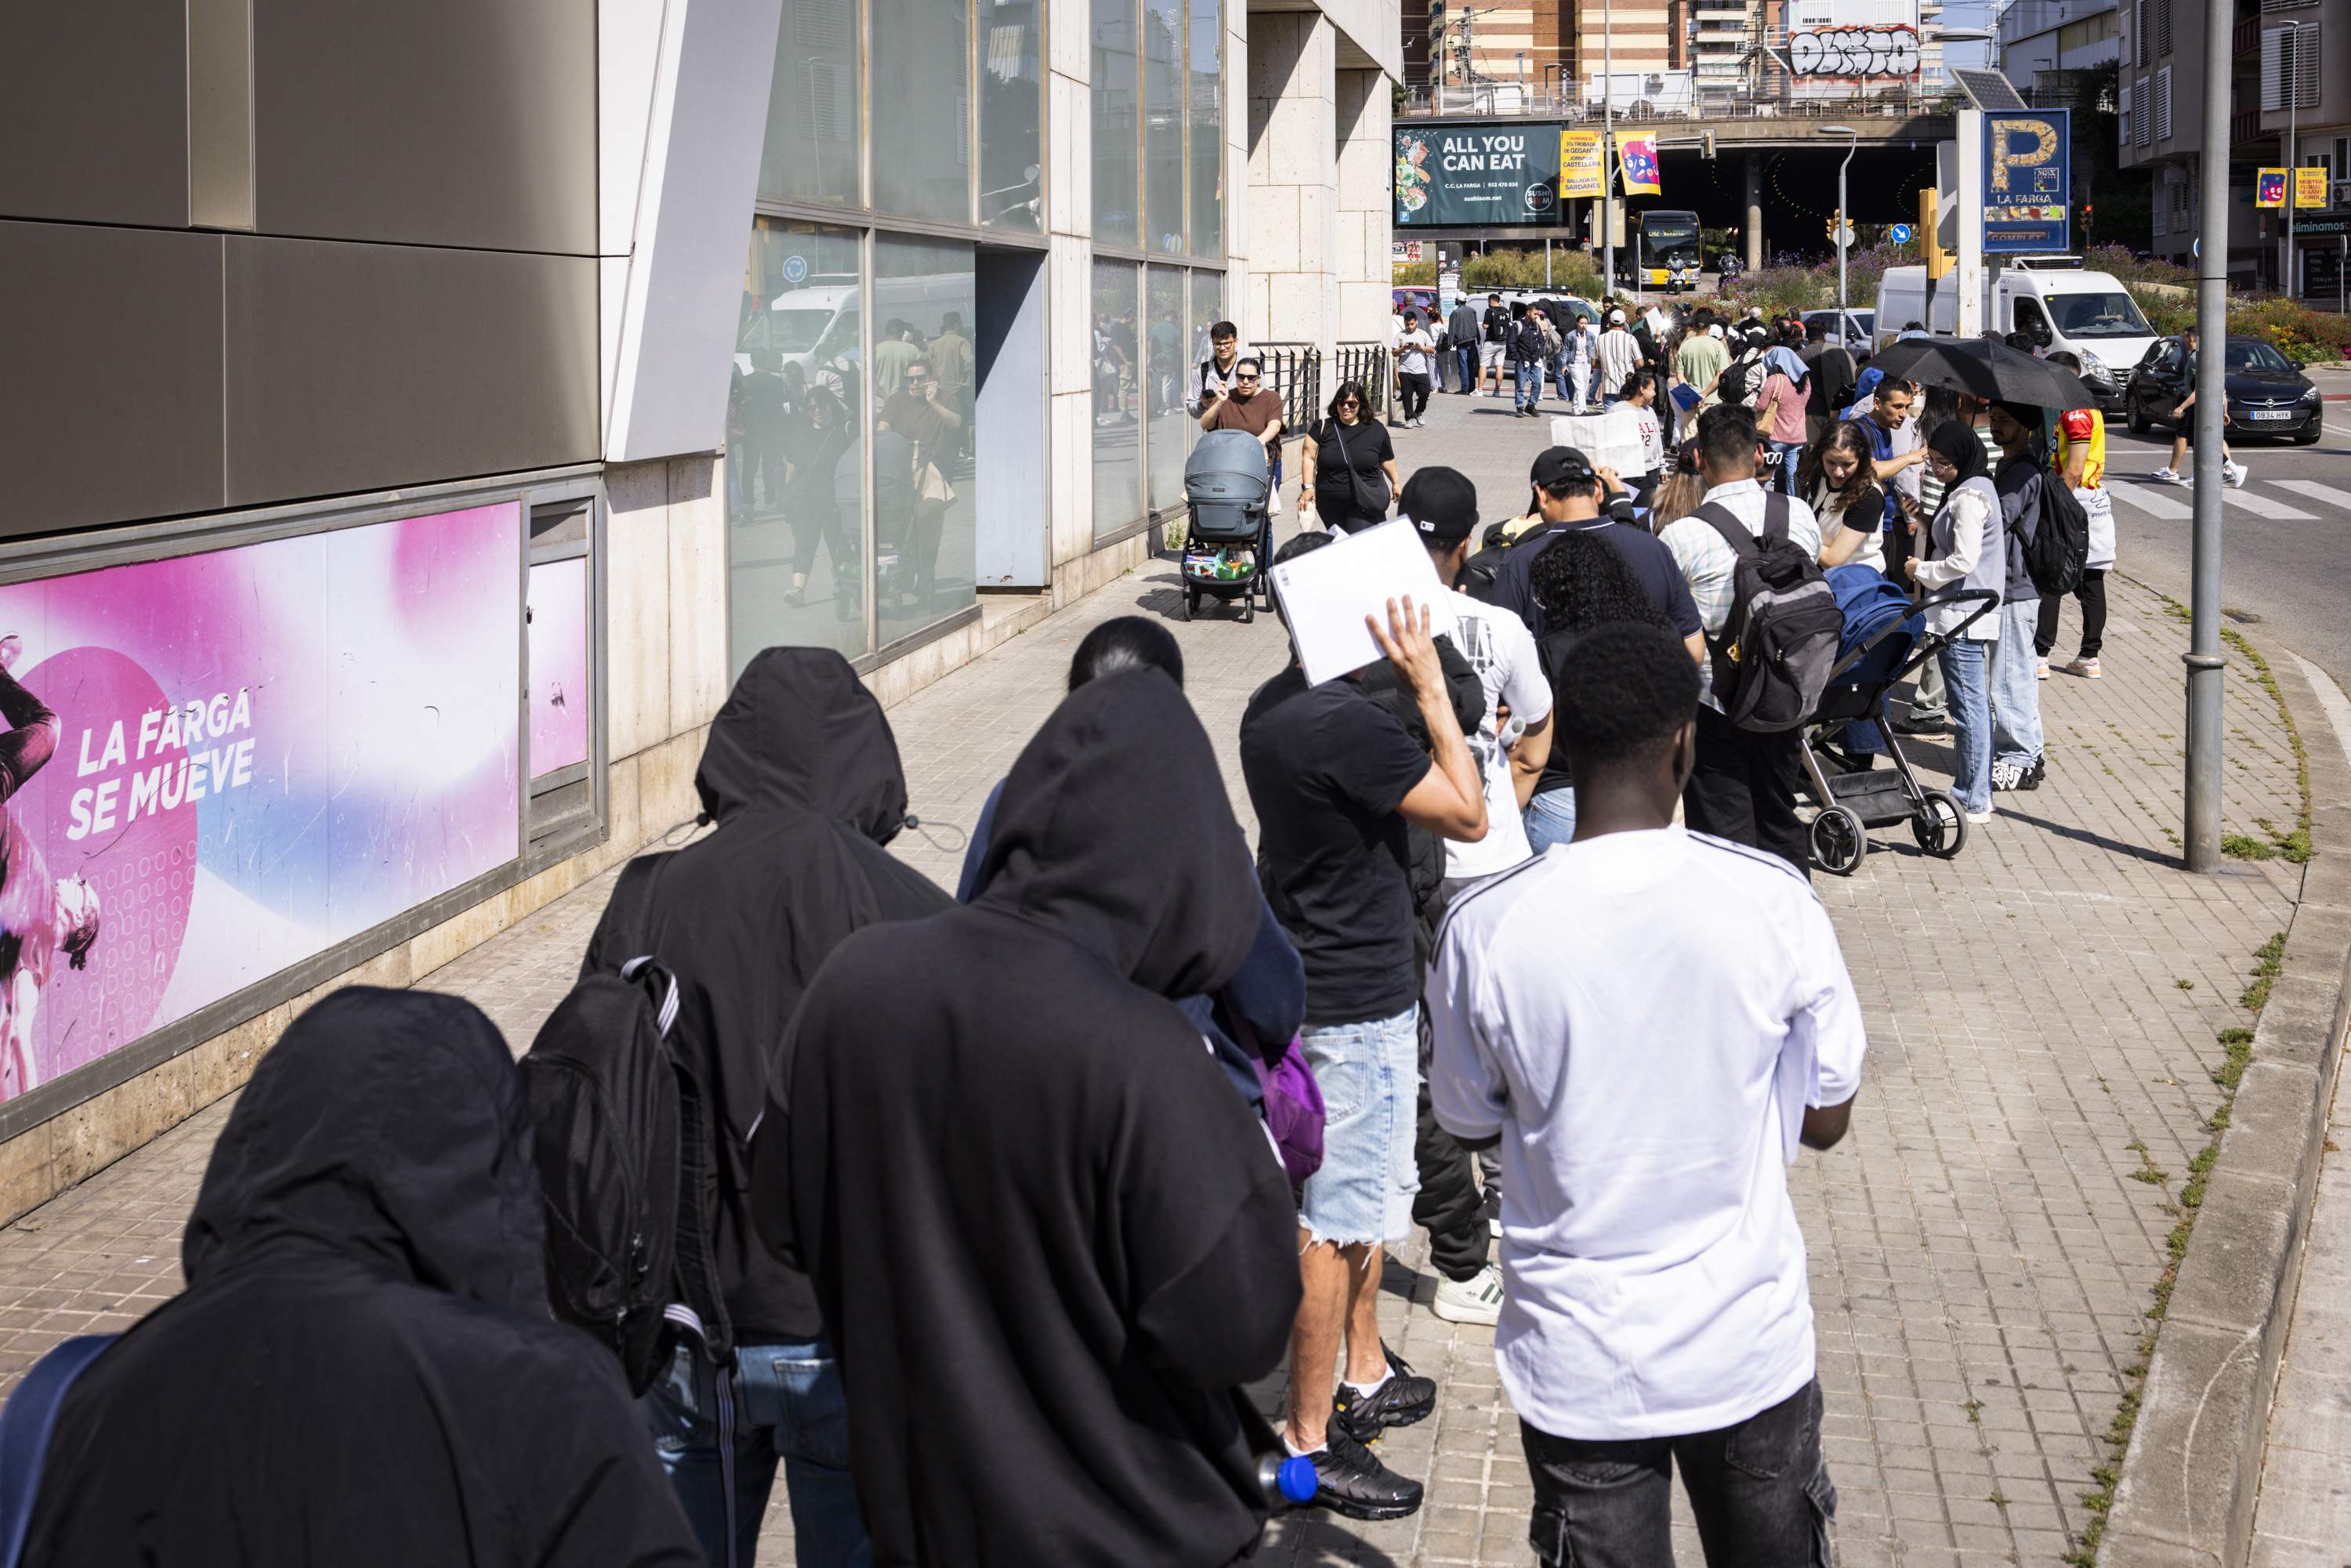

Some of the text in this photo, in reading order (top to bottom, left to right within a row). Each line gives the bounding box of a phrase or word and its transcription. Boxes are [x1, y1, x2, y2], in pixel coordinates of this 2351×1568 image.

[1443, 136, 1524, 153] ALL YOU
[1444, 154, 1525, 171] CAN EAT
[1991, 119, 2057, 192] P
[1998, 194, 2052, 204] LA FARGA
[77, 686, 251, 777] LA FARGA
[66, 737, 255, 841] SE MUEVE
